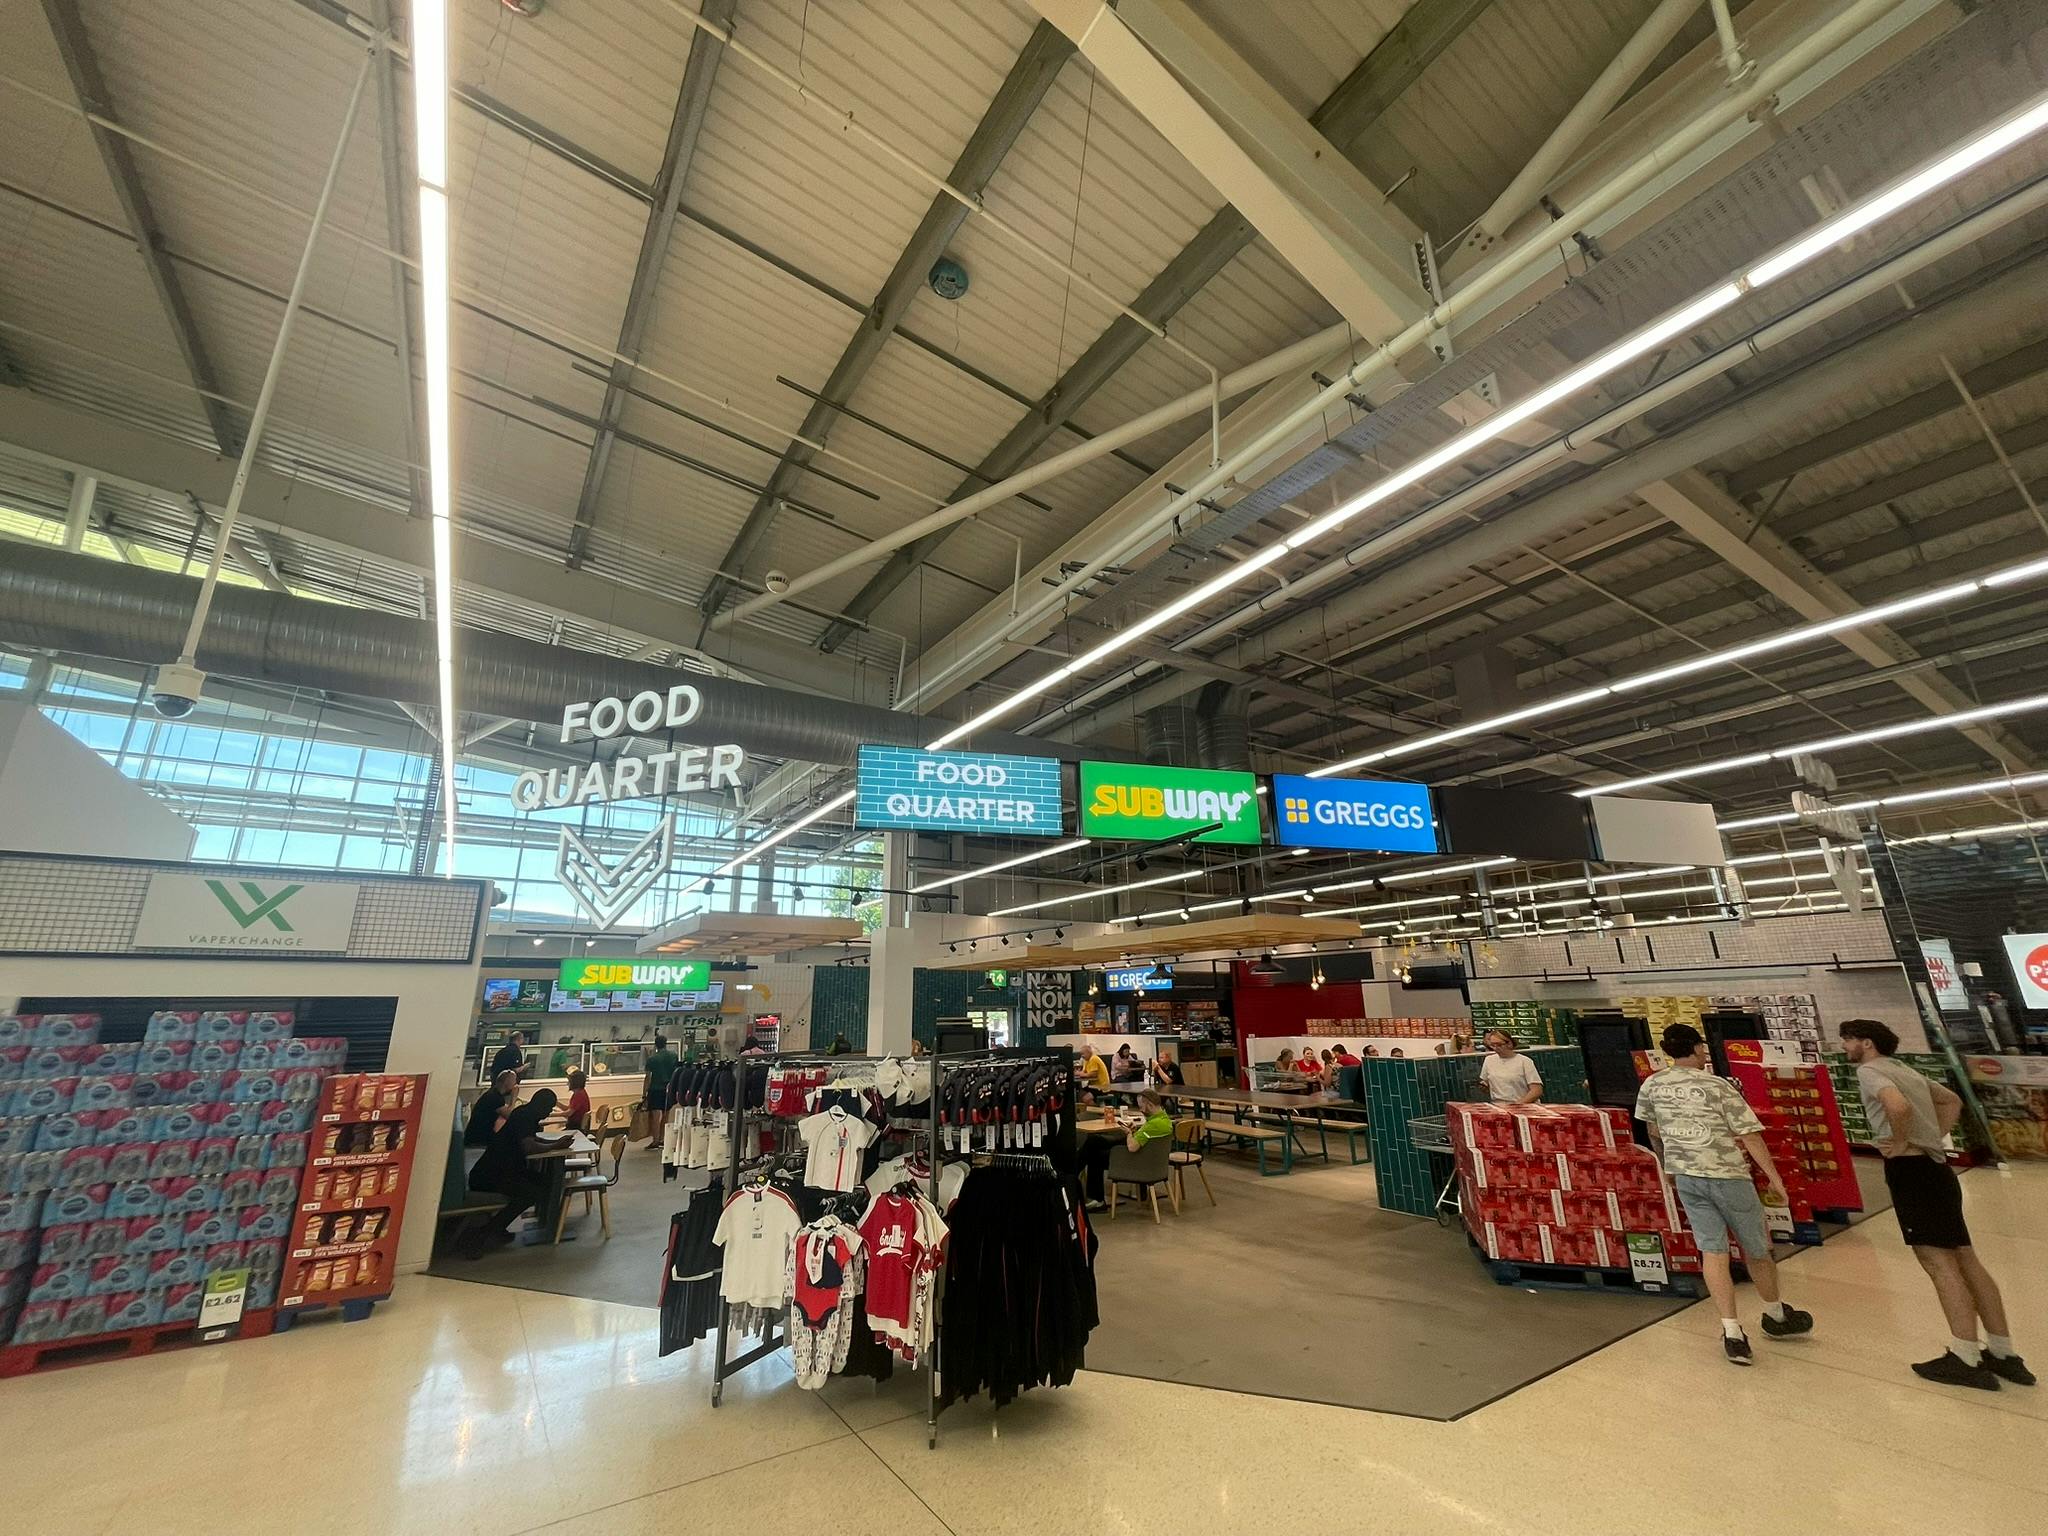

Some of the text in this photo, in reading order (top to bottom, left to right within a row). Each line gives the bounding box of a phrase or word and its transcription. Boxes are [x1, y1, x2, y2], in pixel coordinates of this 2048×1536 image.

[561, 685, 702, 743] FOOD
[511, 744, 743, 811] QUARTER
[918, 761, 1007, 787] FOOD
[887, 794, 1035, 822] QUARTER
[1089, 785, 1251, 822] SUBWAY
[1315, 799, 1425, 829] GREGGS
[188, 935, 304, 946] VAPEXCHANGE
[578, 964, 694, 985] SUBWAY
[1027, 991, 1072, 1009] NOM
[656, 1013, 723, 1026] Eat Fresh
[1634, 1259, 1662, 1269] £8.72
[205, 1294, 241, 1308] £2.62
